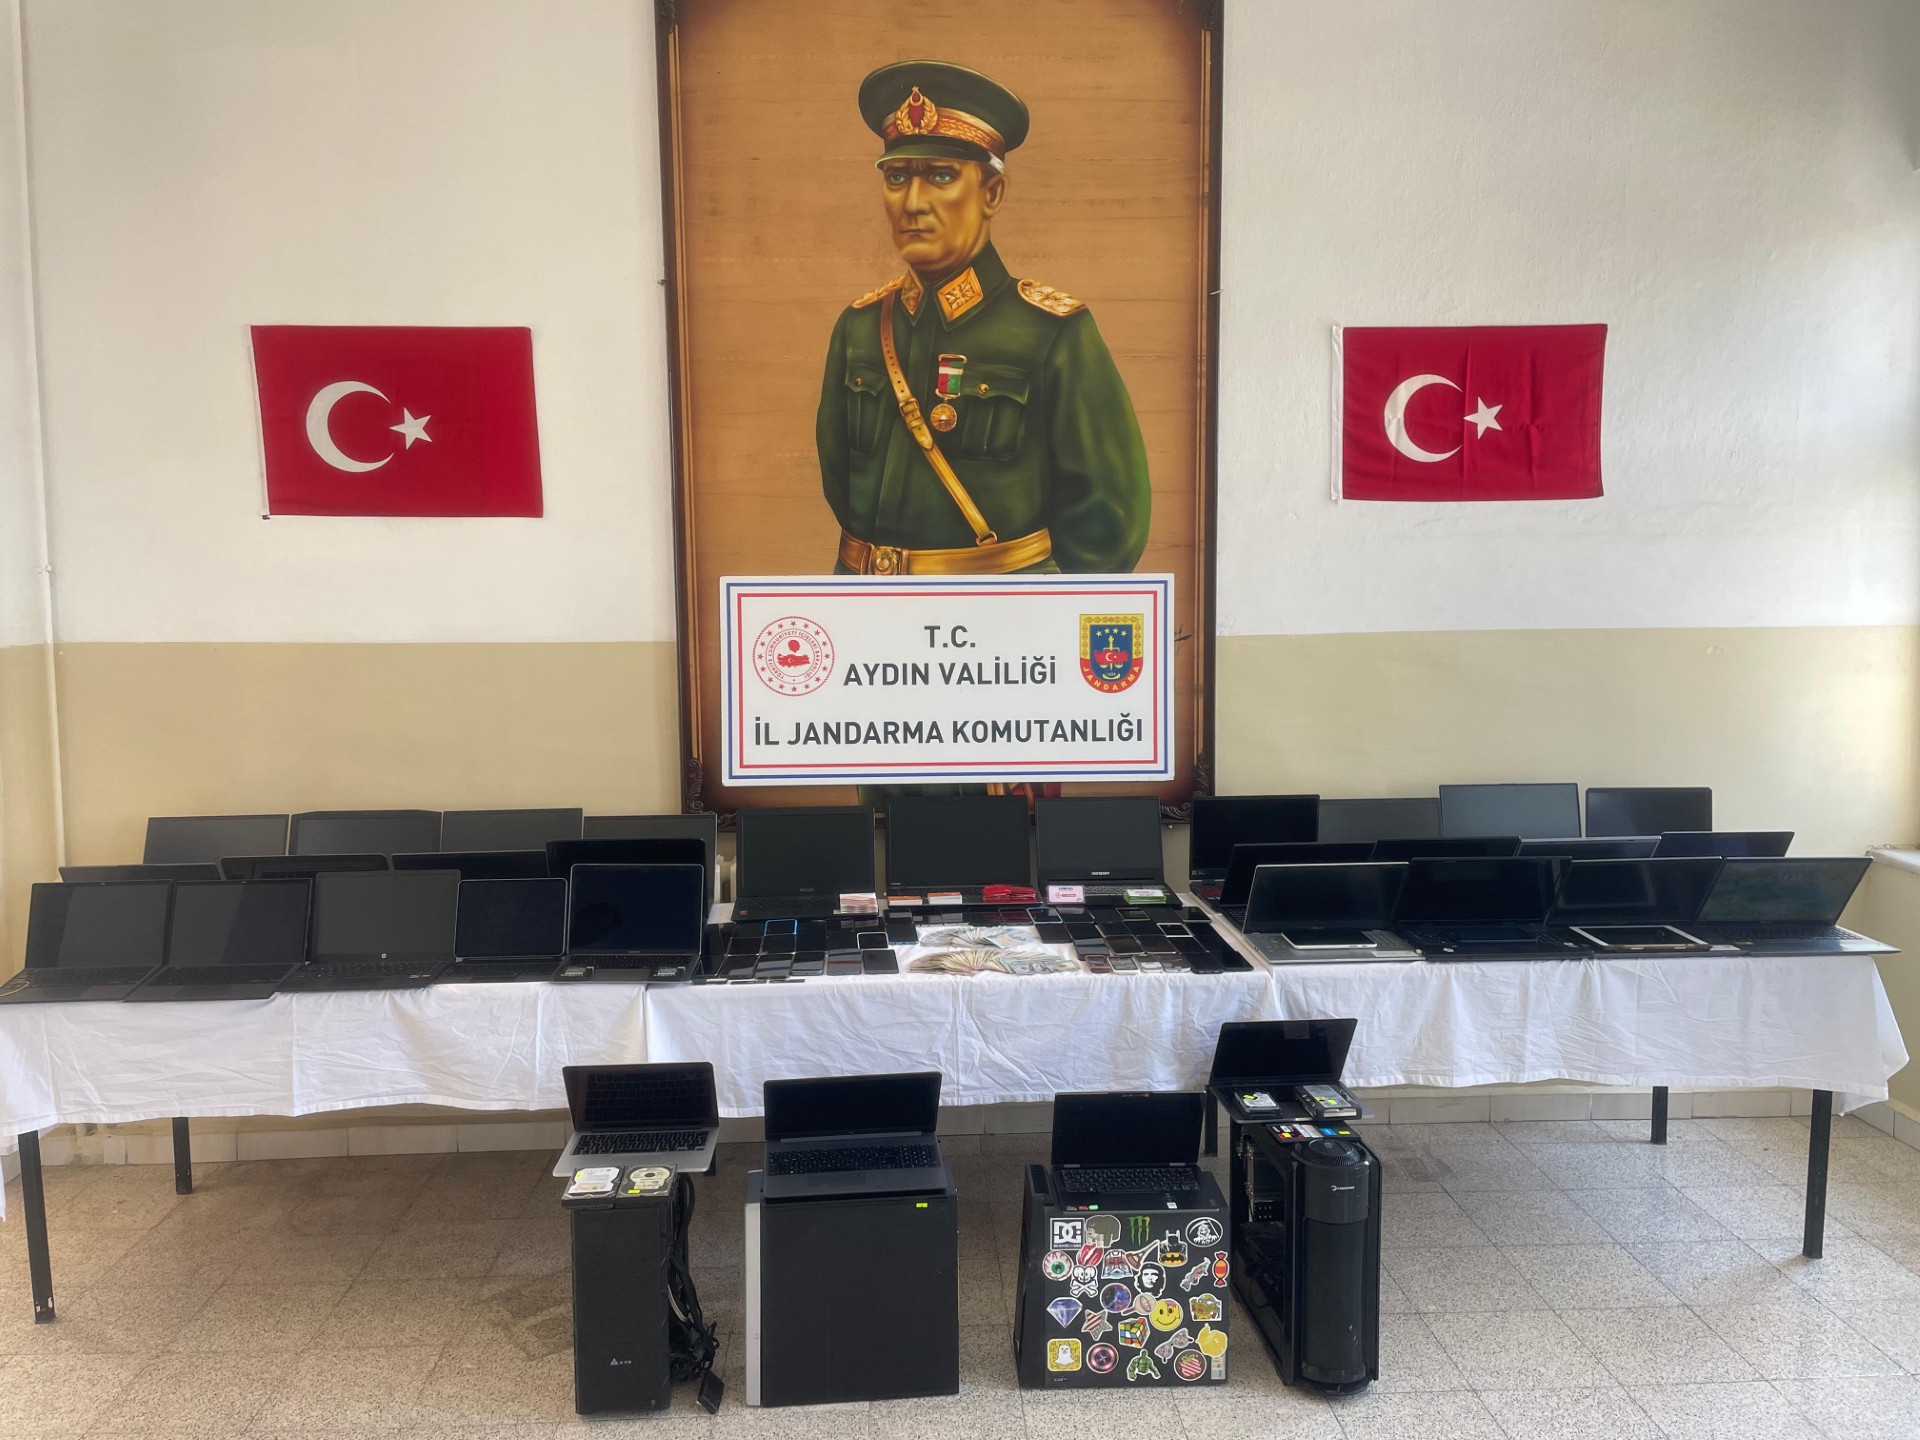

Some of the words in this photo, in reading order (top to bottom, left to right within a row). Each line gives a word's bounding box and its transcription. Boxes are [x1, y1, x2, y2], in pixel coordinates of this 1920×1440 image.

[924, 625, 976, 648] T.C.
[843, 662, 929, 686] AYDIN
[938, 655, 1056, 685] VALİLİĞİ
[1083, 666, 1140, 691] JANDARMA
[755, 716, 780, 746] İL
[787, 720, 944, 746] JANDARMA
[952, 712, 1142, 744] KOMUTANLIĞI
